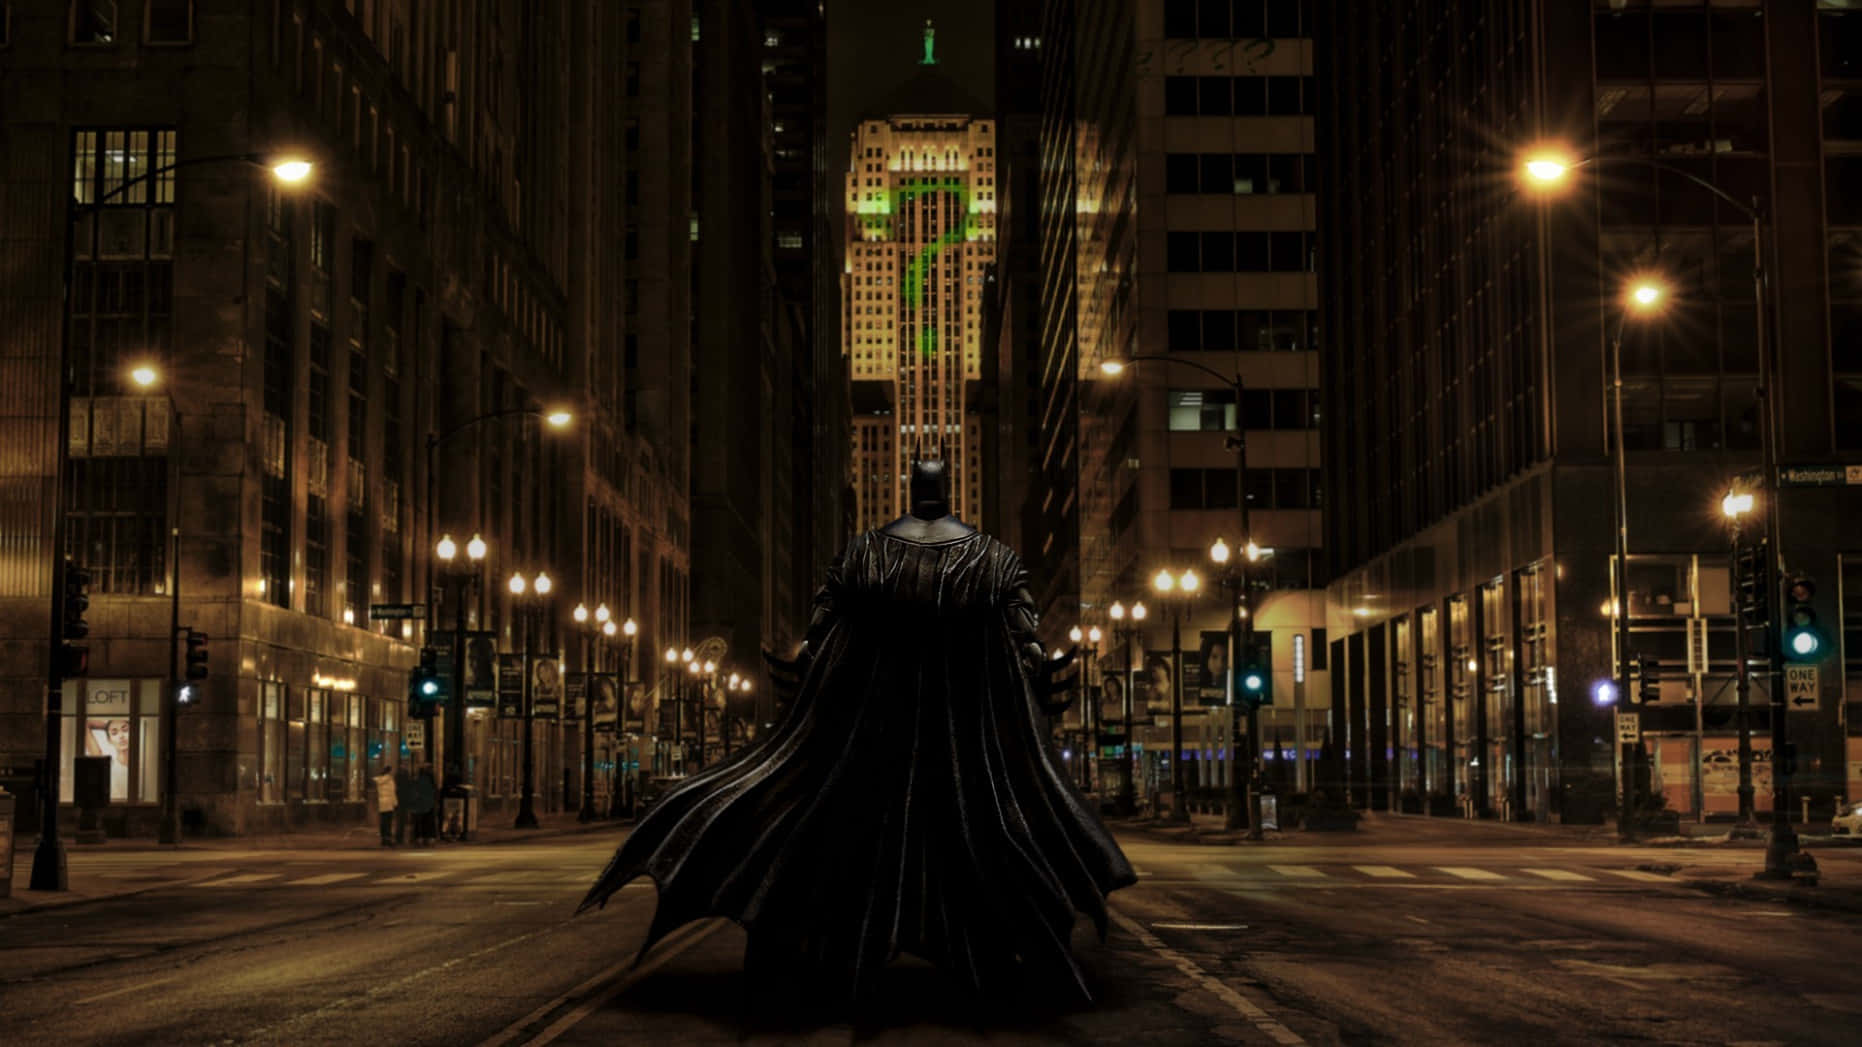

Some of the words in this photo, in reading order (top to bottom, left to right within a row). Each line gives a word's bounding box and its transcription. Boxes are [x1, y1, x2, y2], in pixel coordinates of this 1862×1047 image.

[1787, 469, 1835, 486] Washington
[1789, 668, 1815, 681] ONE
[1790, 682, 1815, 694] WAY
[87, 690, 128, 704] LOFT
[1620, 724, 1636, 732] WAY
